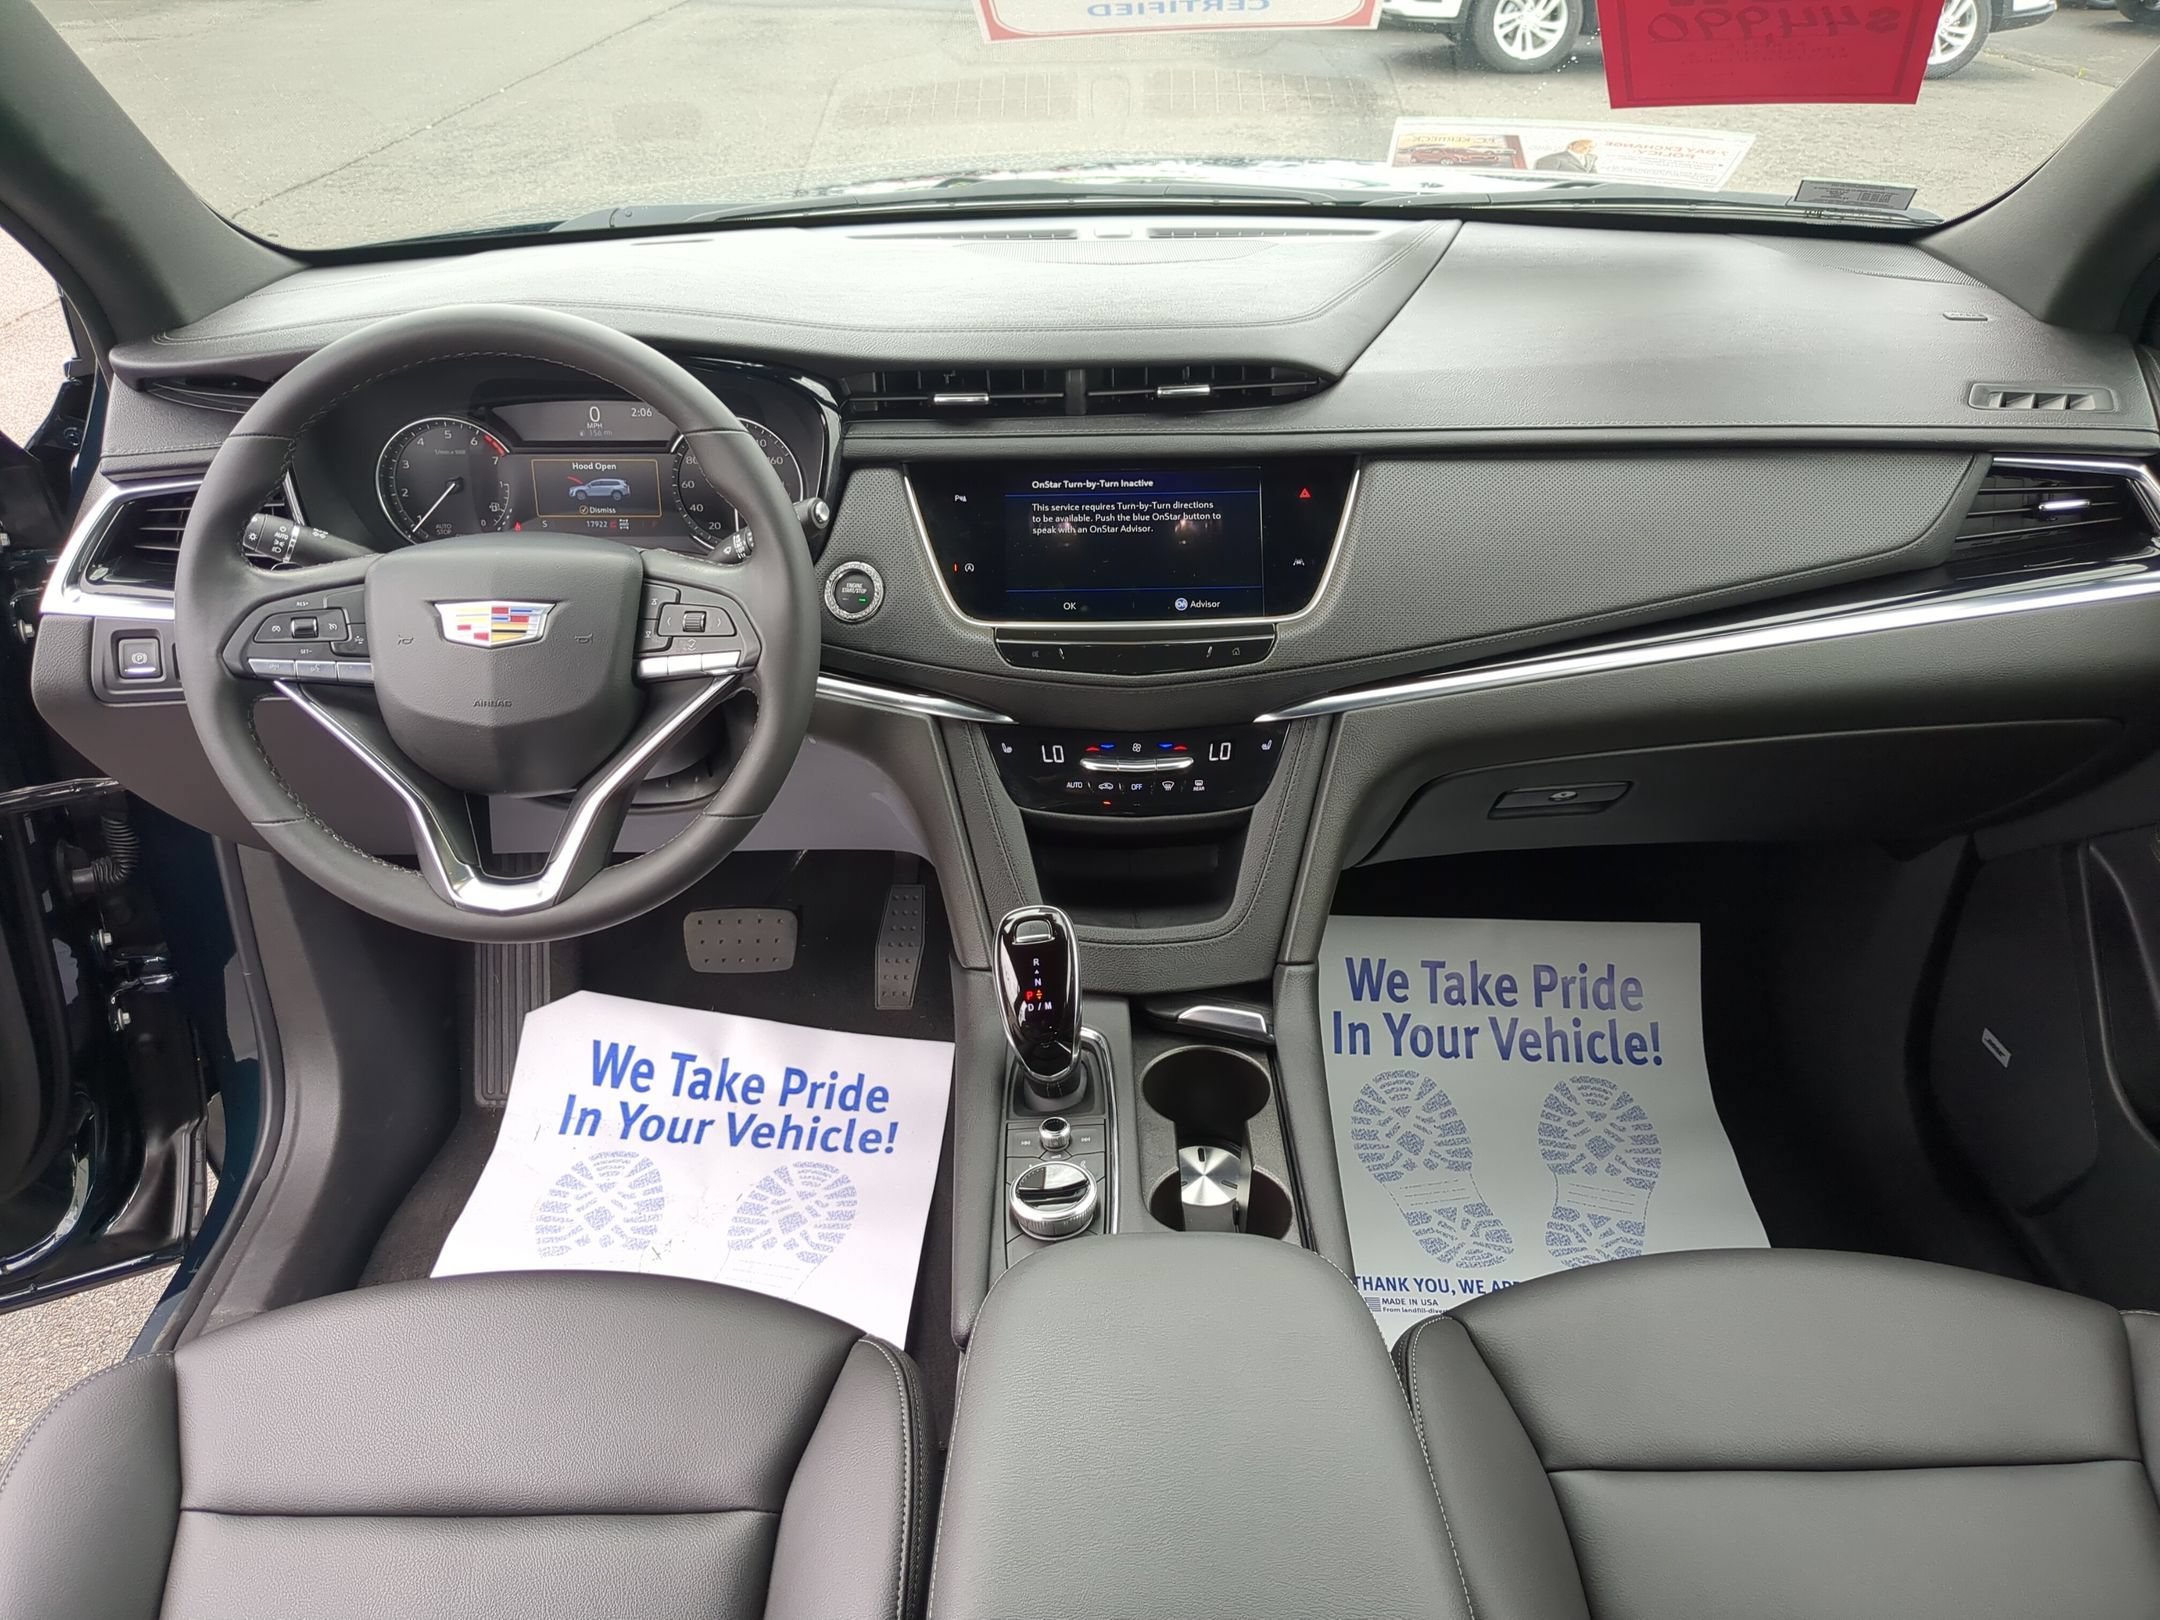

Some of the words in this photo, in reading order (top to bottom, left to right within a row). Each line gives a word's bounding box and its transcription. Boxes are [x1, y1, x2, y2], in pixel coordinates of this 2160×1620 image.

[589, 406, 600, 422] 0
[631, 408, 653, 417] 2:06
[444, 430, 452, 439] 5
[470, 437, 478, 446] 6
[491, 456, 499, 465] 7
[572, 462, 593, 470] Hood
[595, 463, 617, 471] Open
[681, 480, 695, 488] 60
[1031, 480, 1062, 489] OnStar
[1063, 479, 1119, 490] Turn-by-Turn
[1120, 479, 1154, 488] Inactive
[589, 506, 617, 514] Dismiss
[690, 503, 704, 512] 40
[1032, 503, 1049, 511] This
[1051, 503, 1080, 511] service
[1081, 503, 1116, 513] requires
[1117, 501, 1171, 512] Turn-by-Turn
[1172, 500, 1214, 509] directions
[1032, 515, 1041, 523] to
[1042, 514, 1054, 523] be
[1055, 513, 1093, 523] available.
[1095, 513, 1116, 522] Push
[1117, 513, 1131, 521] the
[1132, 512, 1150, 521] blue
[1151, 512, 1181, 521] OnStar
[1183, 511, 1211, 520] button
[1212, 512, 1222, 520] to
[586, 520, 608, 529] 17922
[708, 522, 721, 530] 20
[1032, 525, 1057, 536] speak
[1058, 525, 1076, 534] with
[1077, 525, 1088, 533] an
[1089, 525, 1119, 534] OnStar
[1120, 524, 1154, 533] Advisor.
[274, 531, 289, 540] AUTO
[1063, 601, 1077, 610] OK
[1190, 600, 1221, 608] Advisor
[1041, 744, 1065, 763] LO
[1209, 742, 1232, 761] LO
[1066, 781, 1083, 789] AUTO
[1131, 783, 1143, 791] OFF
[1033, 958, 1040, 966] R
[1034, 978, 1042, 986] N
[1344, 956, 1409, 1003] We
[1420, 959, 1518, 1007] Take
[1532, 963, 1644, 1011] Pride
[1026, 991, 1033, 1000] P
[1332, 1010, 1371, 1055] In
[1382, 1012, 1480, 1060] Your
[1488, 1016, 1664, 1066] Vehicle!
[591, 1039, 655, 1093] We
[671, 1051, 766, 1105] Take
[778, 1067, 890, 1114] Pride
[558, 1094, 601, 1137] In
[619, 1100, 714, 1145] Your
[726, 1111, 899, 1154] Vehicle!
[1413, 1277, 1456, 1296] YOU,
[1457, 1279, 1486, 1294] WE
